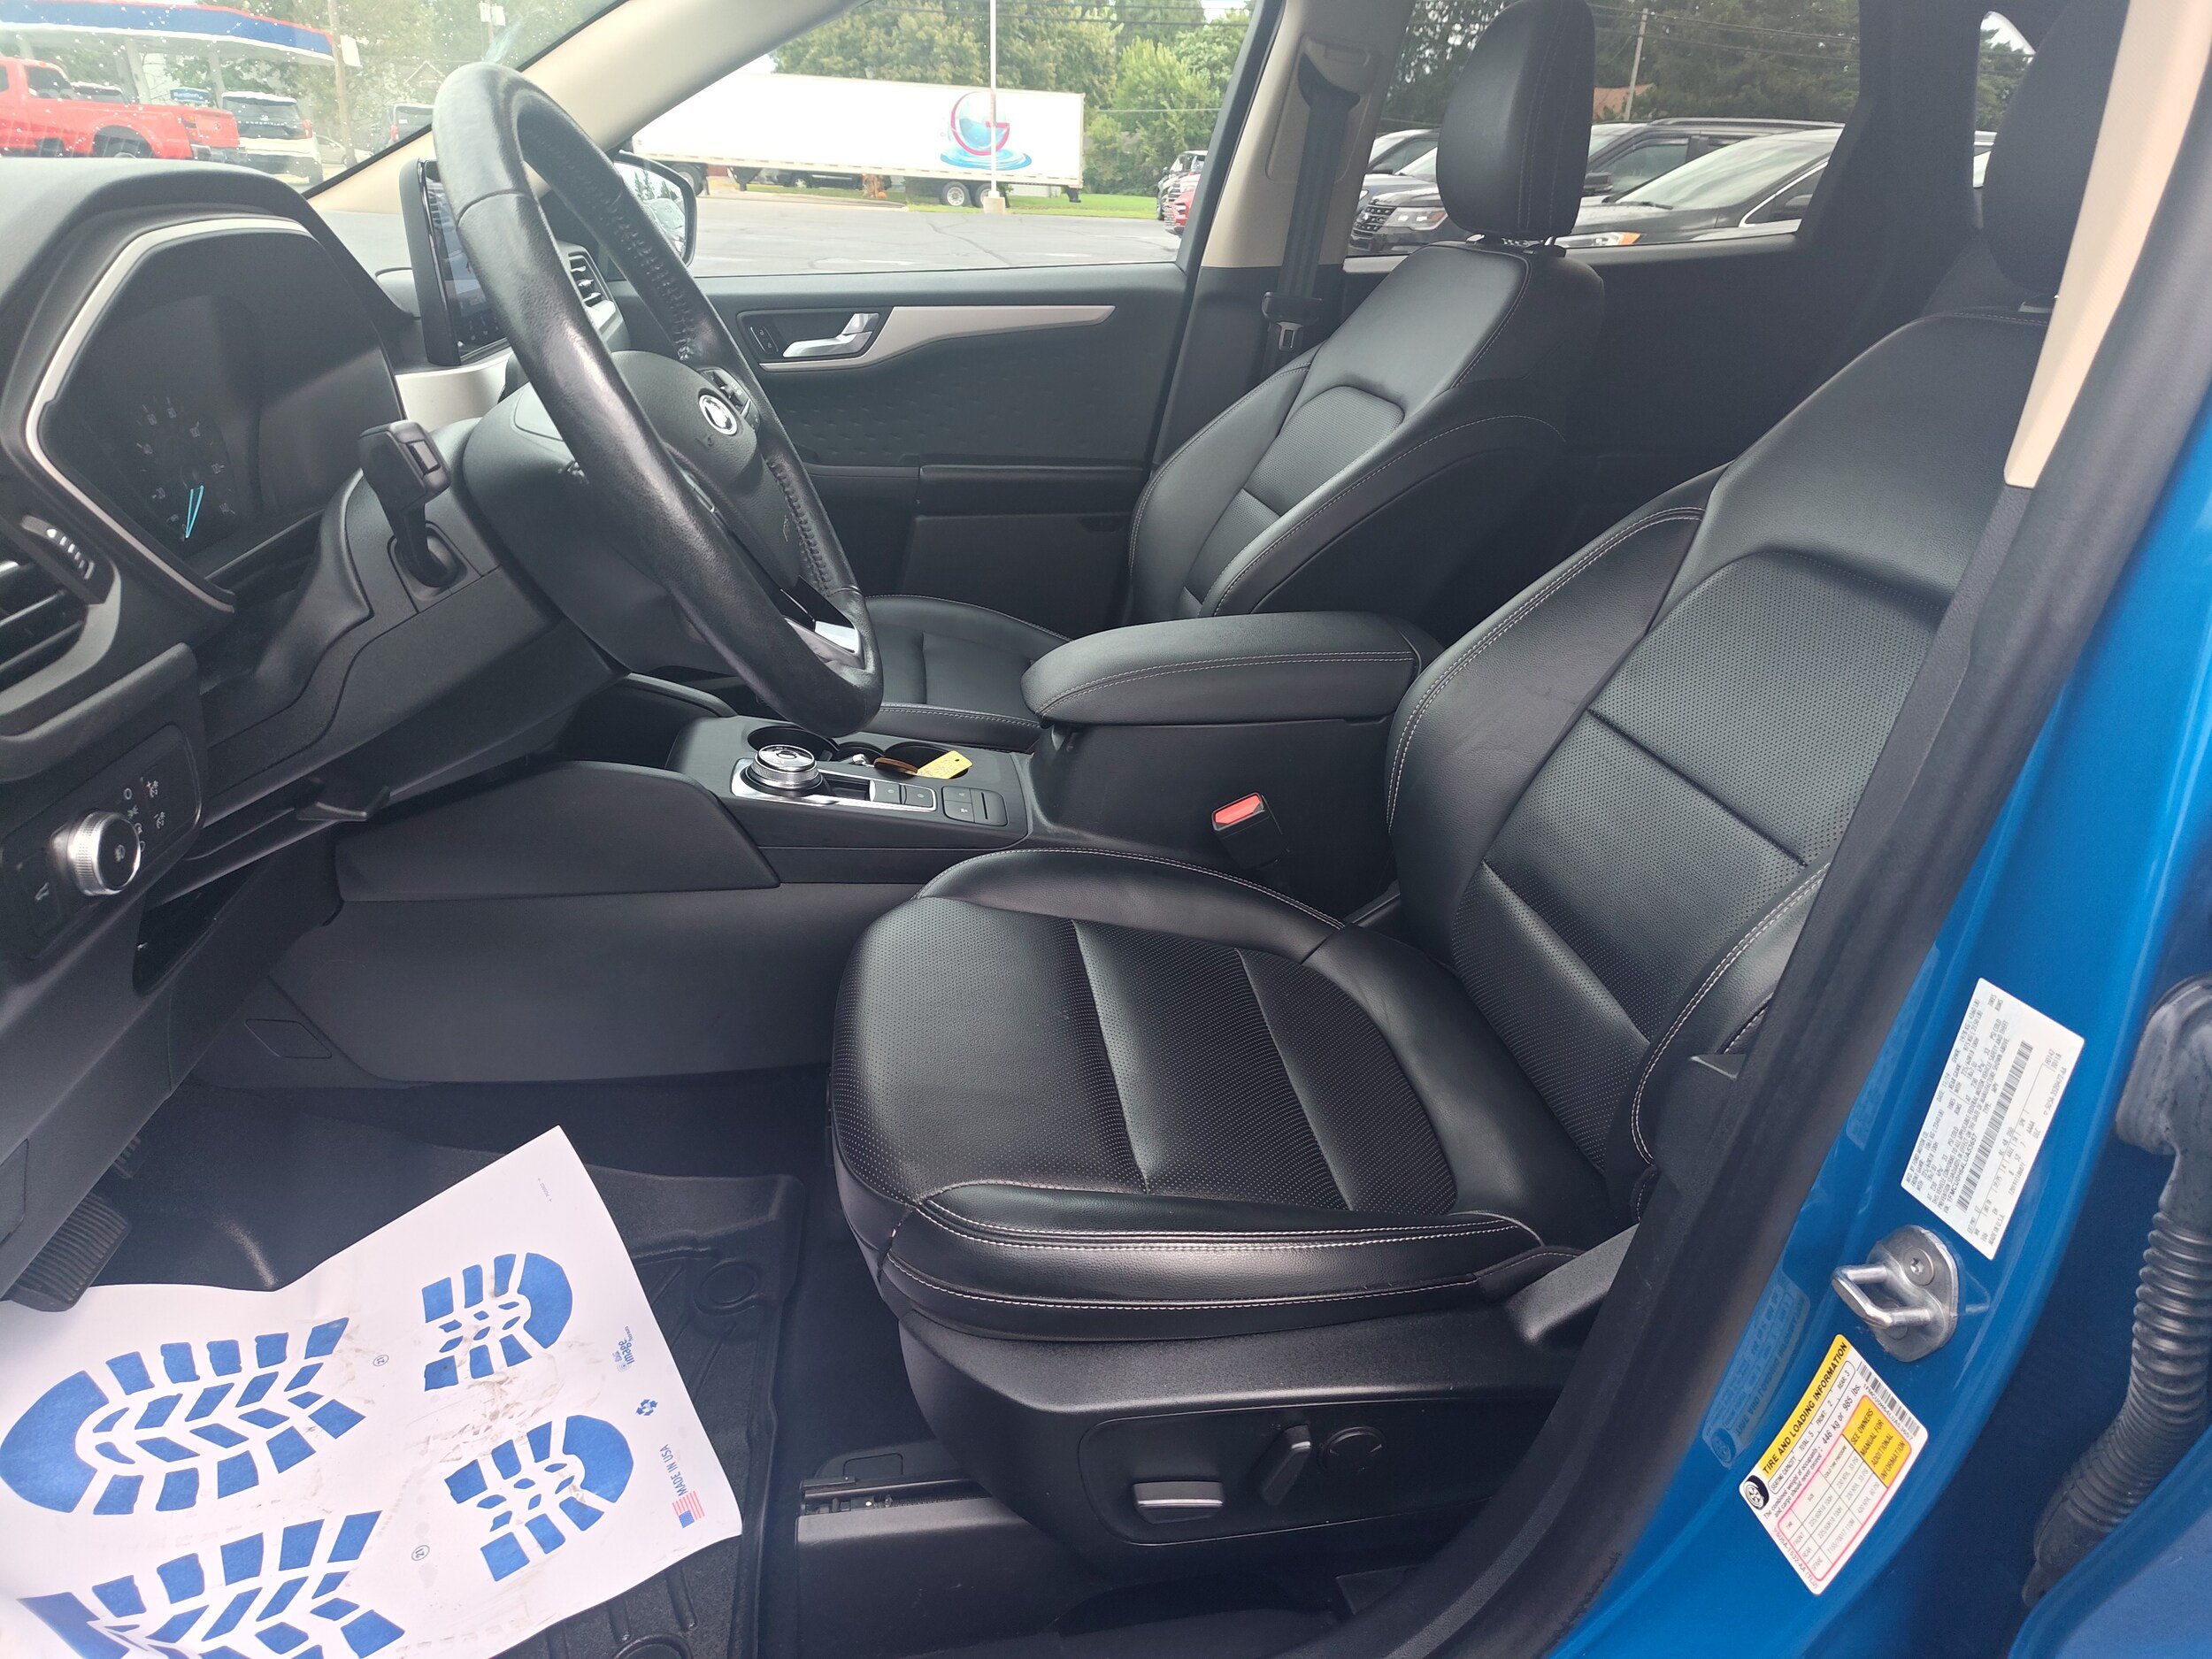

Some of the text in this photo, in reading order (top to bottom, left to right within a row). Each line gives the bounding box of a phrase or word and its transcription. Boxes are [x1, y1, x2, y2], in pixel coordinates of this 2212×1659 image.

[1991, 1051, 2002, 1071] SHOWN
[1978, 1070, 1995, 1103] MANUFACTURE
[1935, 1176, 1946, 1195] VEHICLE
[1942, 1153, 1955, 1179] CONFORMS
[1951, 1146, 1958, 1155] TO
[1956, 1113, 1971, 1141] APPLICABLE
[1966, 1094, 1978, 1116] FEDERAL
[1974, 1078, 1985, 1096] MOTOR
[1980, 1060, 1992, 1079] VEHICLE
[1987, 1043, 1999, 1062] SAFETY
[1993, 1033, 2003, 1045] AND
[1970, 1108, 1980, 1122] DATE
[1976, 1102, 1983, 1110] OF
[1958, 1135, 1970, 1154] EFFECT
[1947, 1156, 1961, 1184] STANDARDS
[1936, 1181, 1951, 1210] PREVENTION
[1987, 1231, 1997, 1246] MADE
[1762, 1340, 1847, 1476] TIRE AND LOADING INFORMATION
[1820, 1428, 1832, 1446] 446
[1830, 1417, 1841, 1432] kg
[1837, 1411, 1845, 1422] or
[1841, 1394, 1853, 1412] 985
[1849, 1407, 1874, 1446] SEE OWNERS
[1859, 1417, 1884, 1457] MANUAL FOR
[1870, 1431, 1893, 1467] ADDITIONAL
[1878, 1439, 1906, 1480] INFORMATION
[659, 1443, 688, 1496] MADE IN USA
[1770, 1487, 1788, 1511] combined
[1786, 1473, 1800, 1491] weight
[1801, 1446, 1818, 1471] occupants
[1780, 1494, 1793, 1510] cargo
[1790, 1479, 1802, 1497] should
